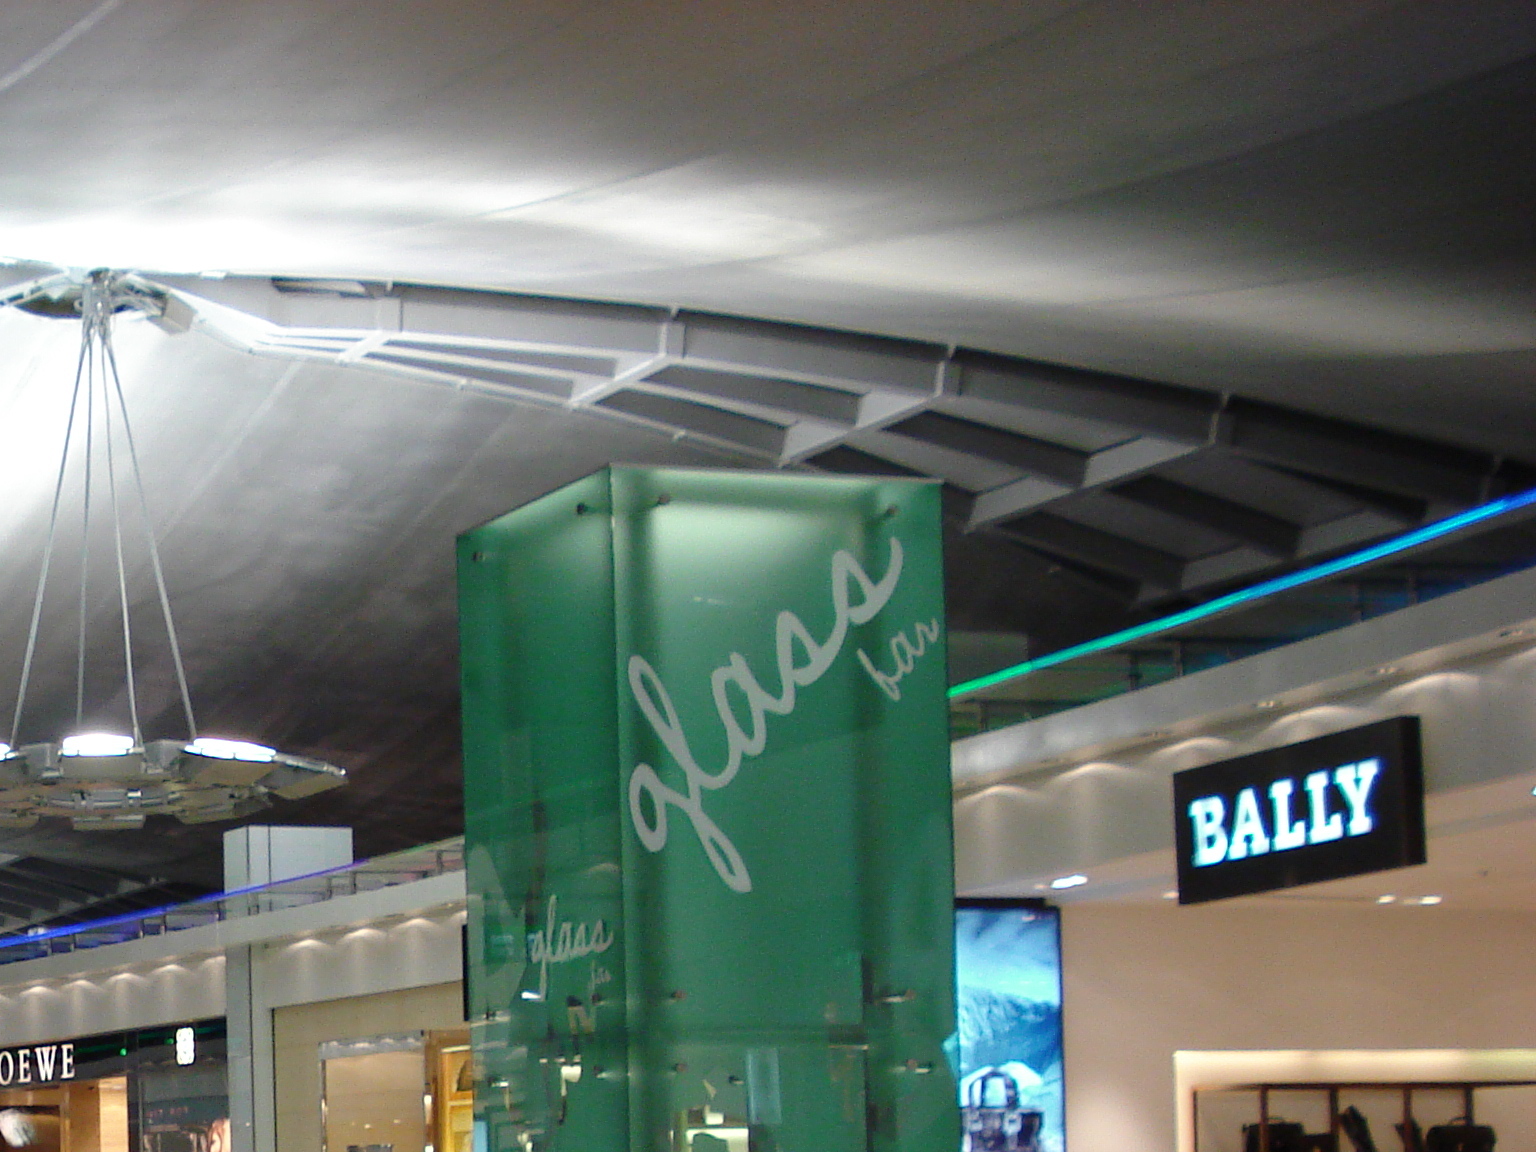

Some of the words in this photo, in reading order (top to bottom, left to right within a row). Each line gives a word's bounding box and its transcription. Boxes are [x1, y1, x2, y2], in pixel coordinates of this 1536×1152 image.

[627, 536, 904, 893] glass
[857, 618, 940, 701] bar
[1186, 756, 1380, 868] BALLY
[530, 893, 614, 1001] glass
